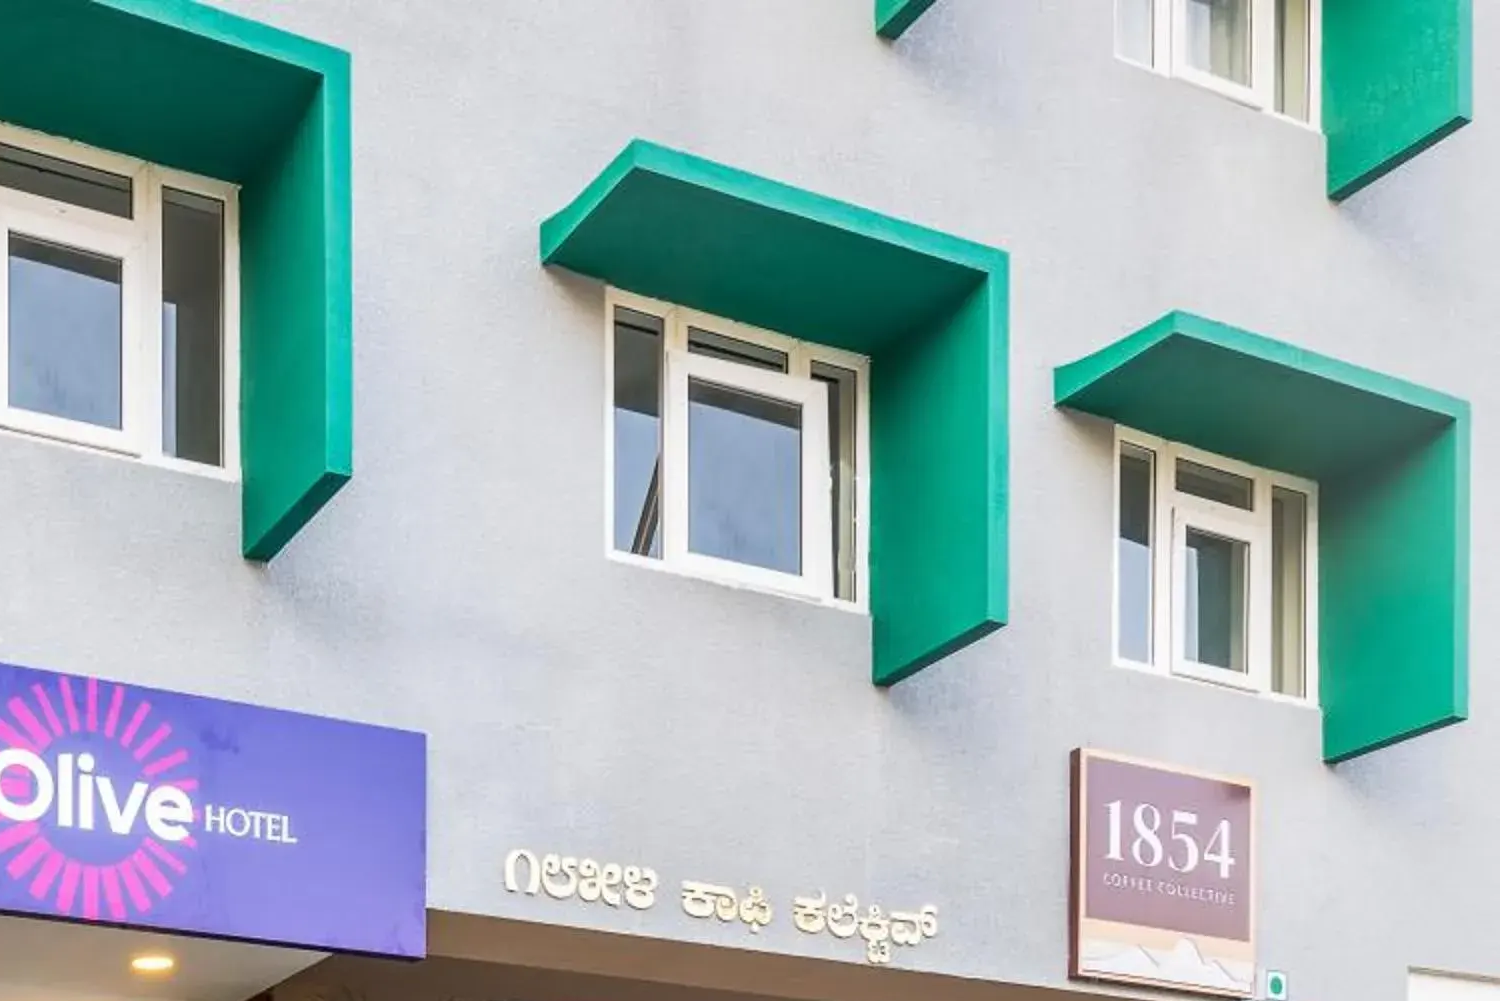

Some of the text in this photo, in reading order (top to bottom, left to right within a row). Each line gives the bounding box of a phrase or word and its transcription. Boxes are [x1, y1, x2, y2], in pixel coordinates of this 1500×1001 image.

[204, 803, 298, 845] HOTEL
[1103, 799, 1236, 880] 1854
[1103, 872, 1153, 893] COFFEE
